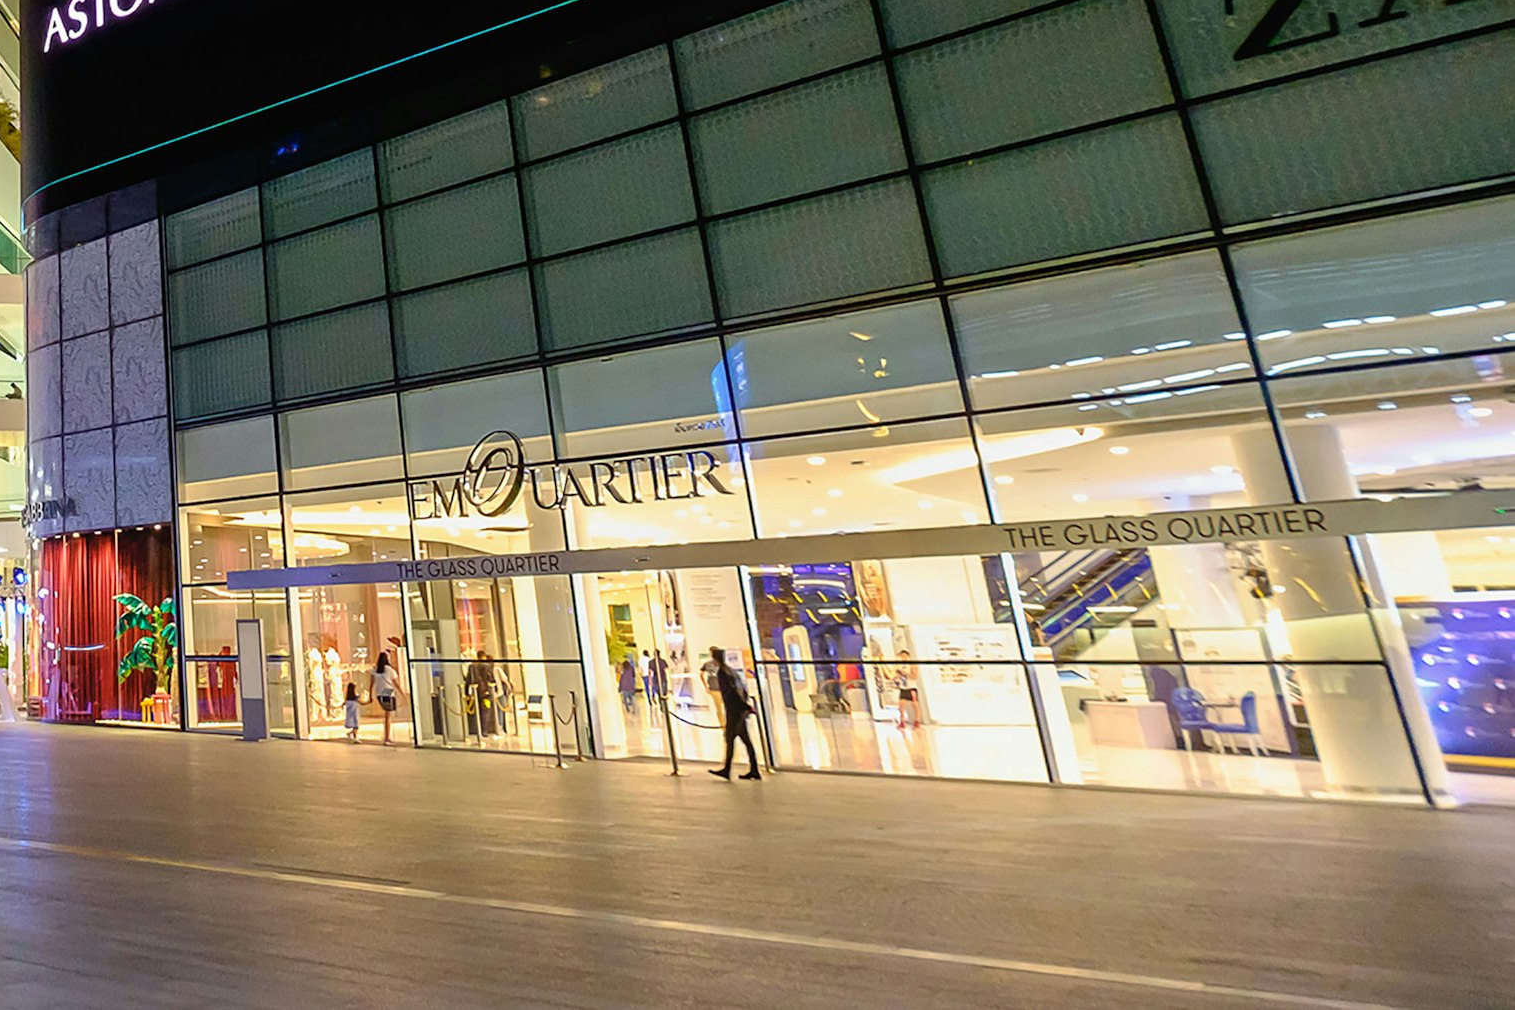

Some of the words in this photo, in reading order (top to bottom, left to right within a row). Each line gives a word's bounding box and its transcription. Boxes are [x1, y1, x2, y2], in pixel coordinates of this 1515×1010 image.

[1002, 525, 1056, 549] THE
[1063, 519, 1159, 545] GLASS
[1166, 508, 1329, 543] QUARTIER
[396, 560, 424, 579] THE
[427, 557, 477, 578] GLASS
[480, 554, 560, 576] QUARTIER
